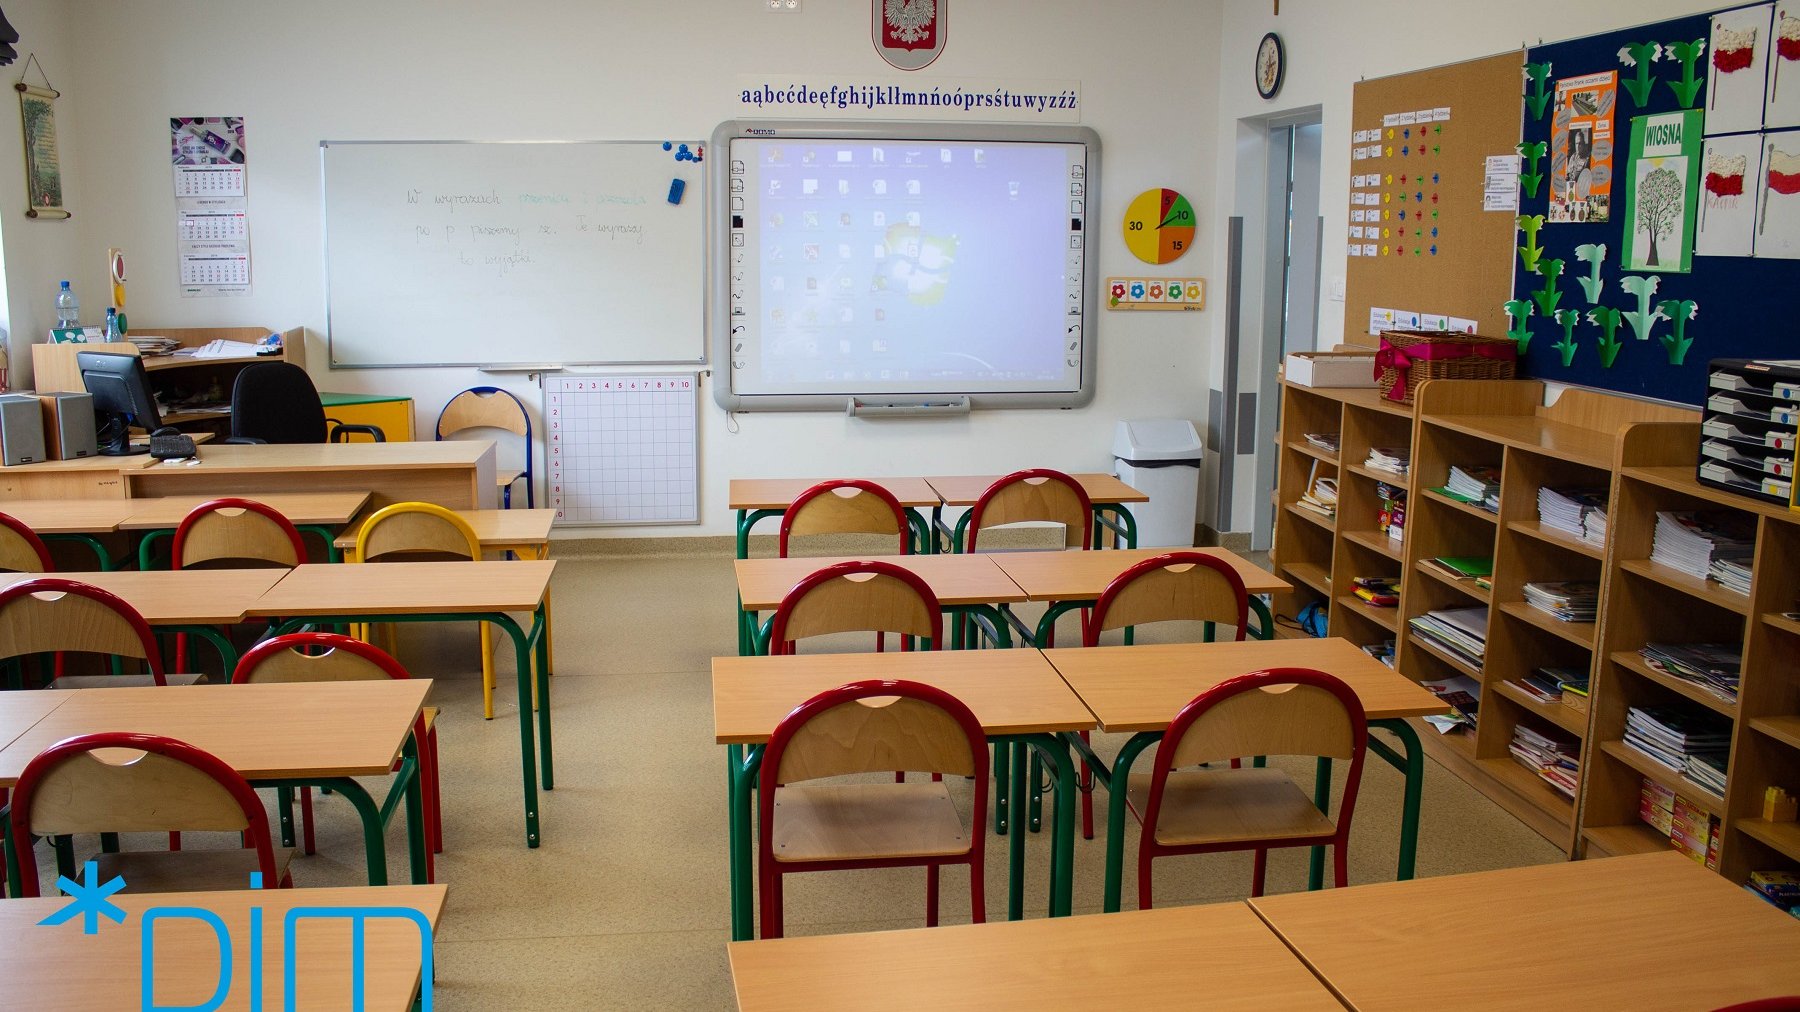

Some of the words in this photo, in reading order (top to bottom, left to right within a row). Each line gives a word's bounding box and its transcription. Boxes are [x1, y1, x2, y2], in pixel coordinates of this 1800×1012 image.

[741, 84, 1076, 112] aąbcćdeęfghijklłmnńoóprsśtuwyzźż
[1645, 122, 1682, 147] WIOSNA
[407, 189, 423, 205] W
[1164, 196, 1170, 205] 5
[1177, 210, 1189, 220] 10
[1129, 221, 1143, 231] 30
[1172, 240, 1183, 251] 15
